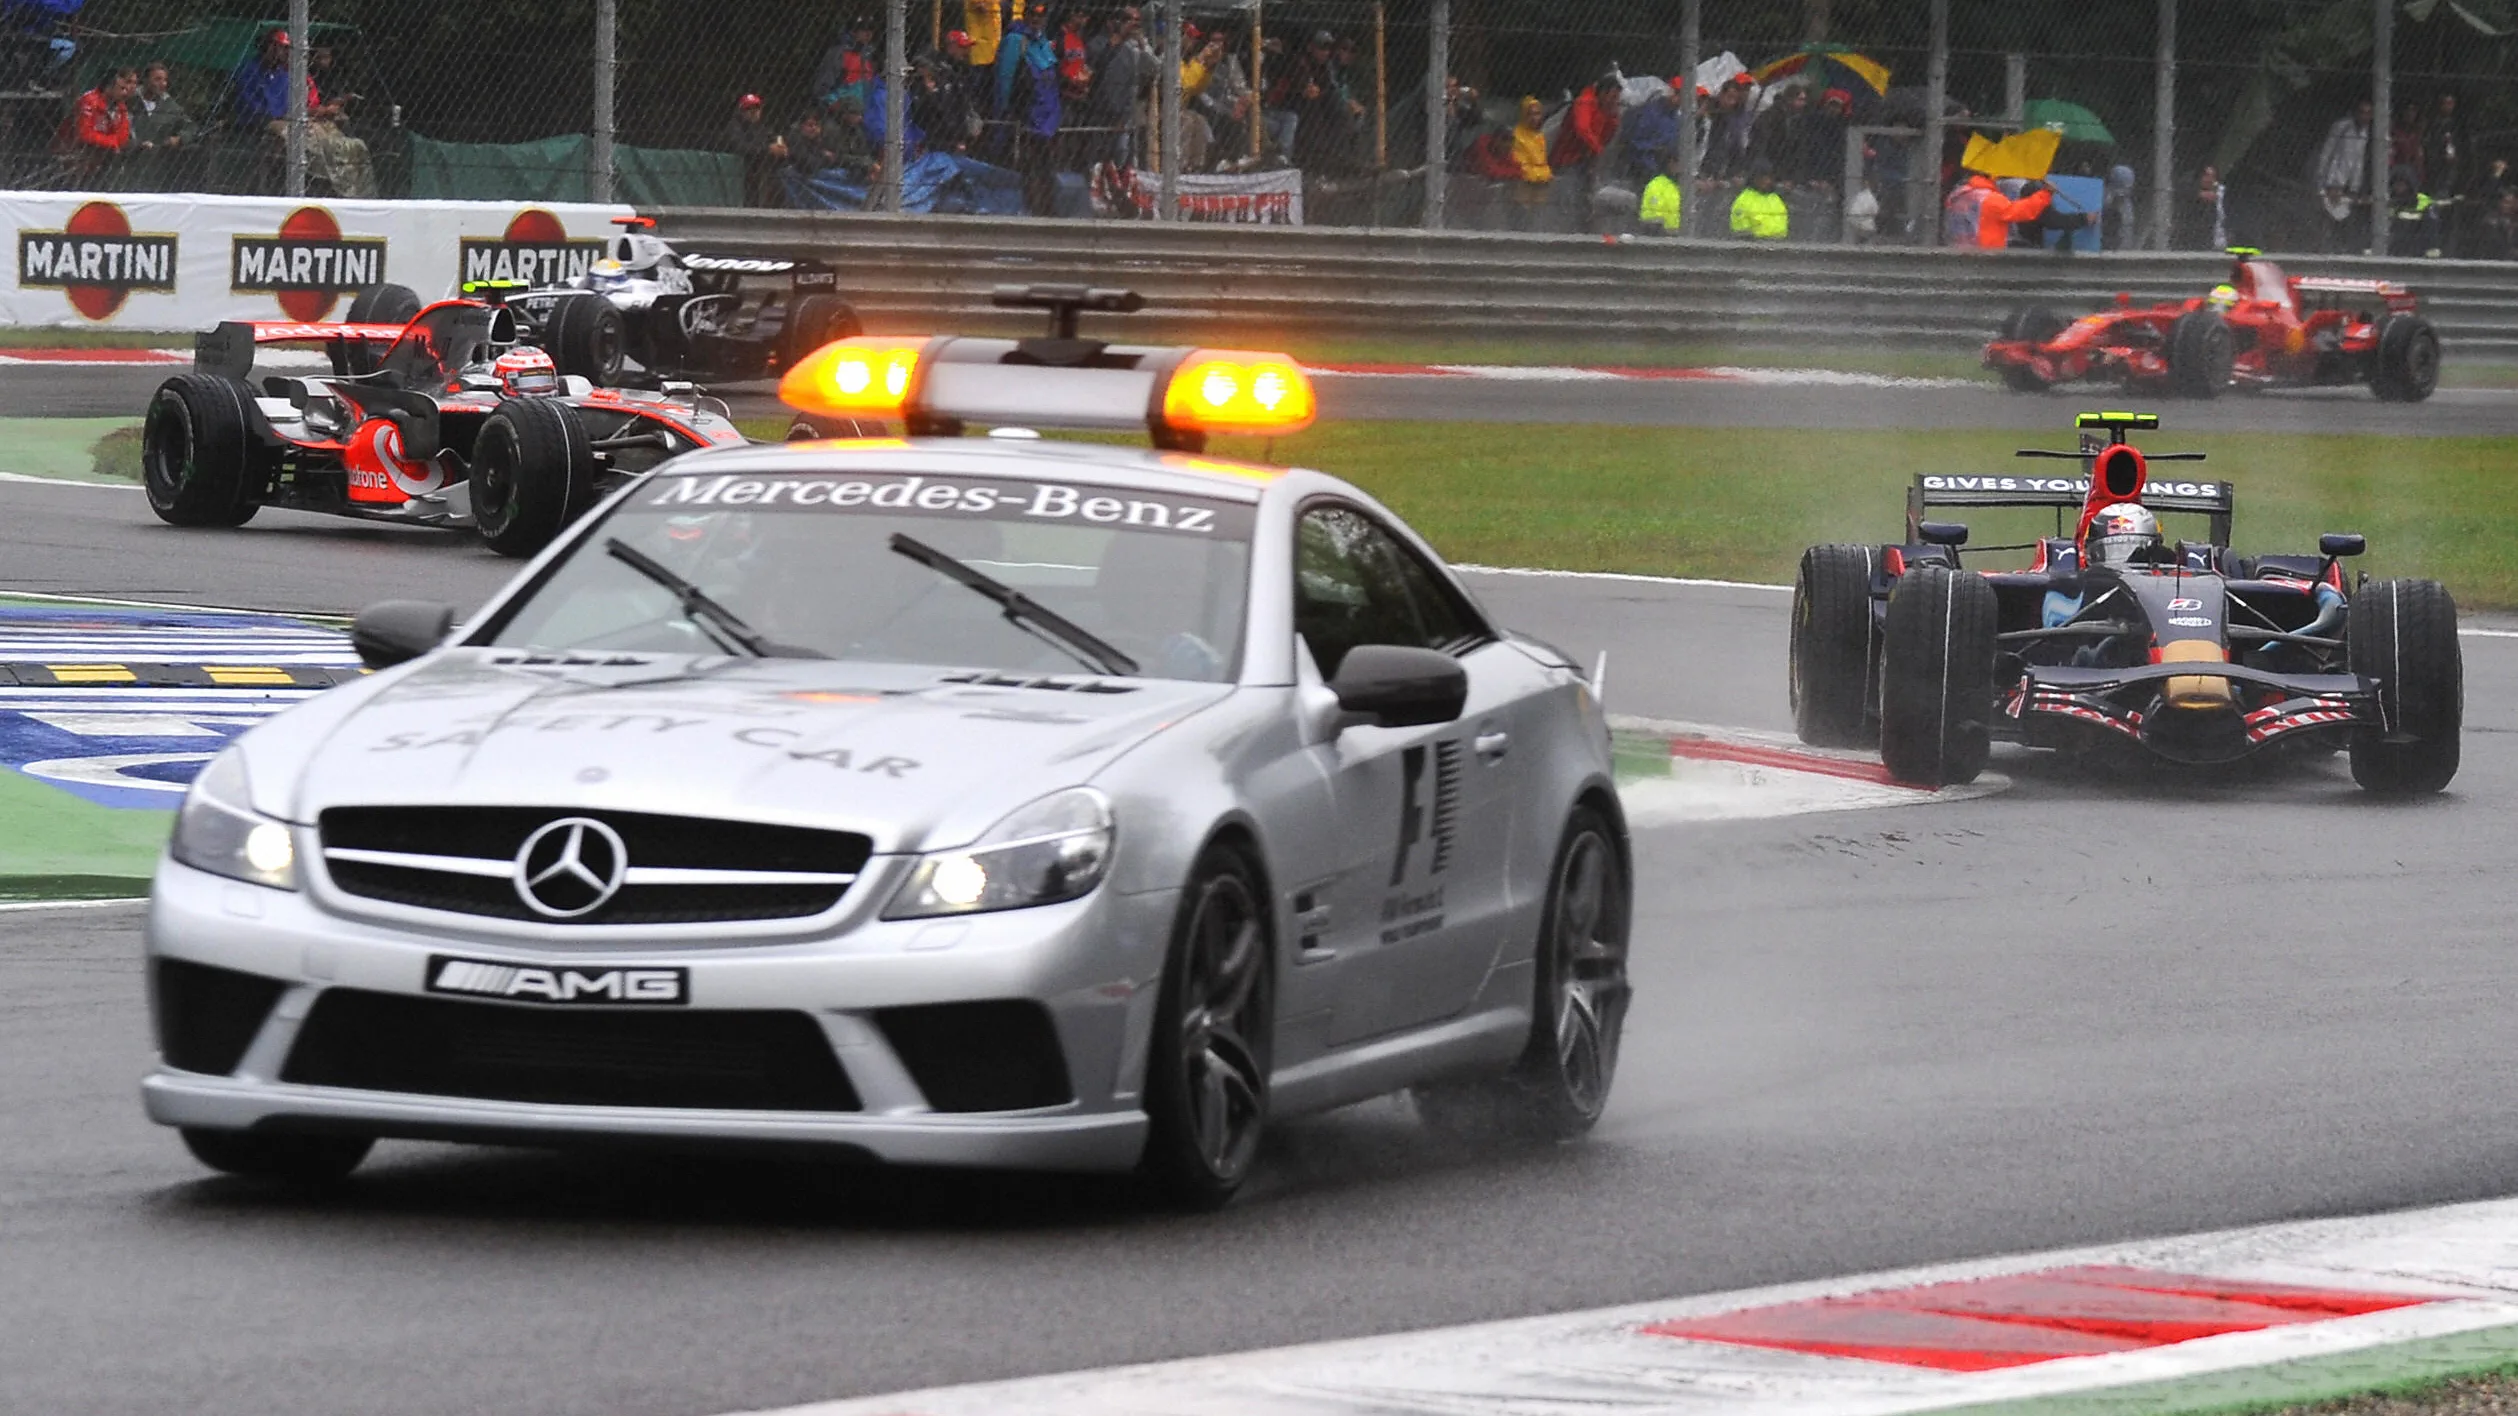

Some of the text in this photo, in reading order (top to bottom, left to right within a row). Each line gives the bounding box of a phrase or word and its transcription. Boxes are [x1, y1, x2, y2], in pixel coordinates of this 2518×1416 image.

[26, 240, 169, 281] MARTINI
[239, 246, 378, 285] MARTINI
[650, 475, 1215, 532] Mercedes-Benz
[1923, 476, 2217, 496] GIVES YOU INGS
[731, 727, 923, 778] CAR
[505, 968, 680, 1000] AMG
